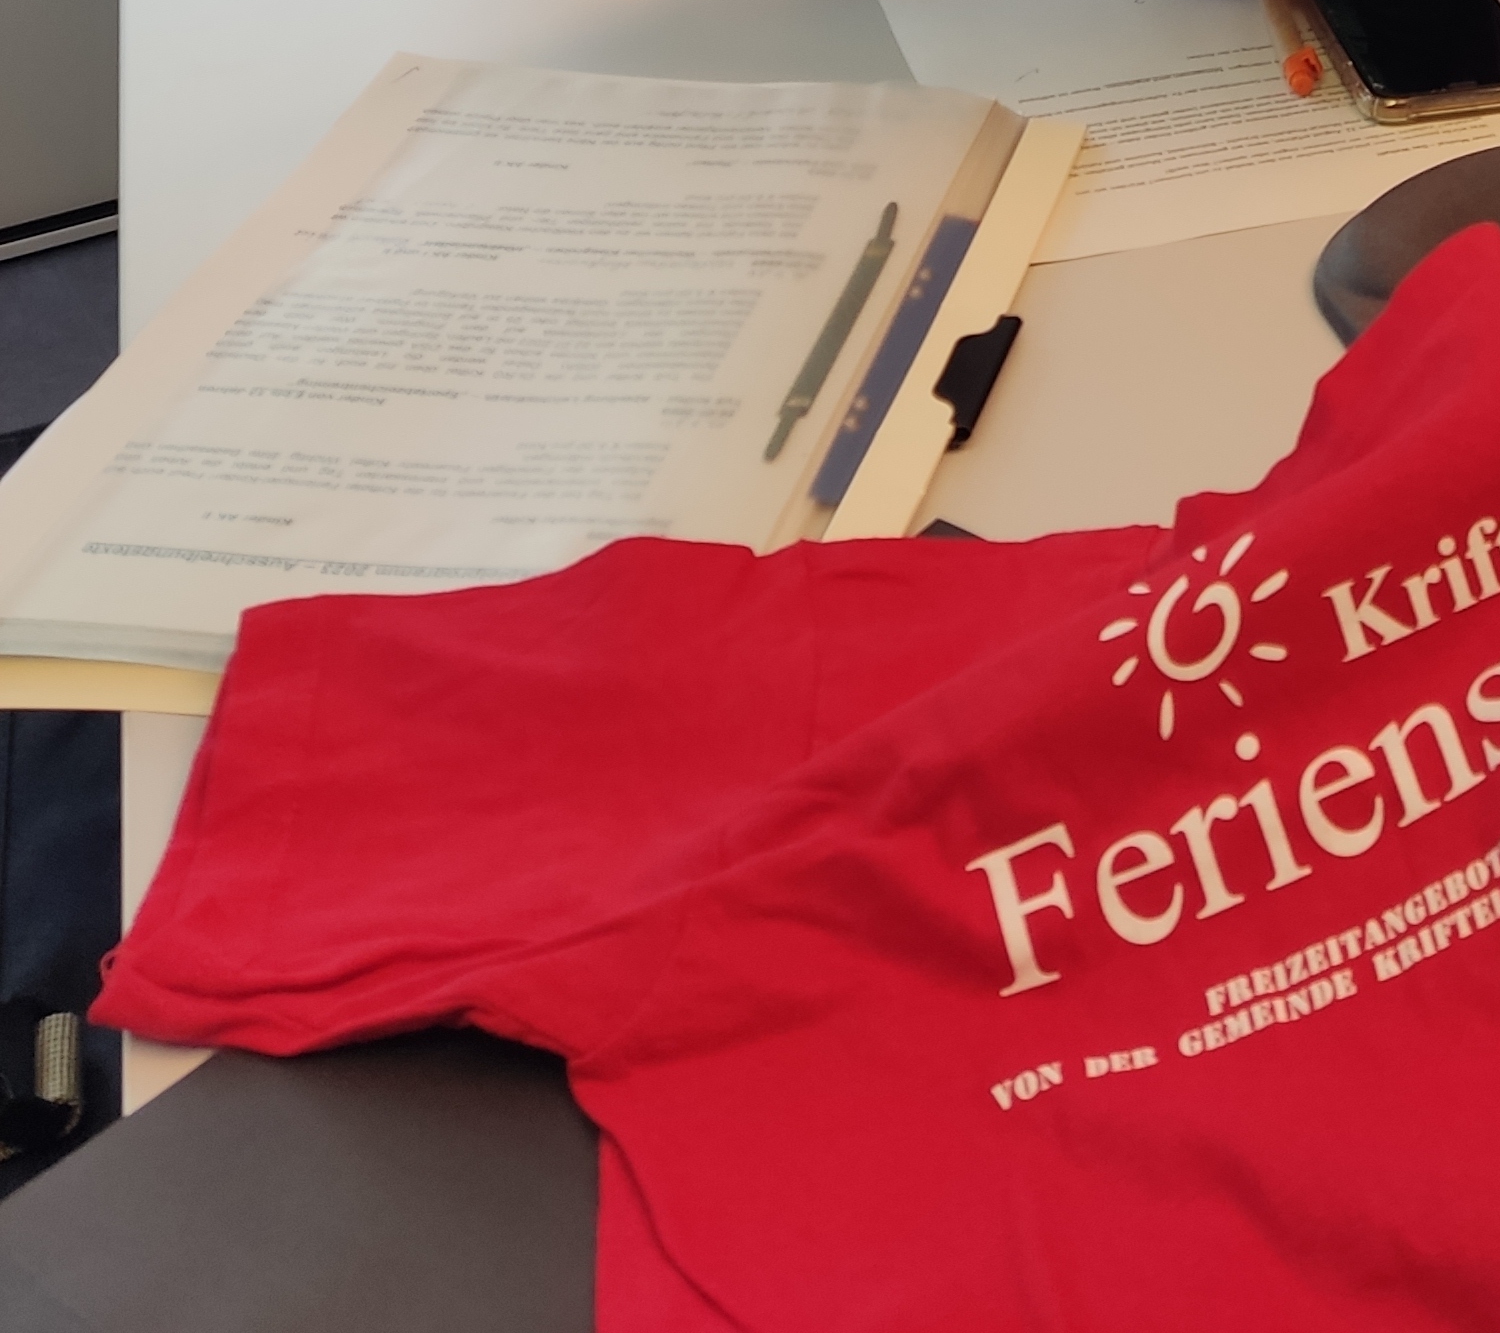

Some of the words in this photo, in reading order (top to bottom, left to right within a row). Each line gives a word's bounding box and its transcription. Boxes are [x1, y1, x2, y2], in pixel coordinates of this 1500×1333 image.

[989, 1061, 1064, 1111] VON
[1083, 1045, 1160, 1079] DER
[1177, 968, 1358, 1058] GEMEINDE
